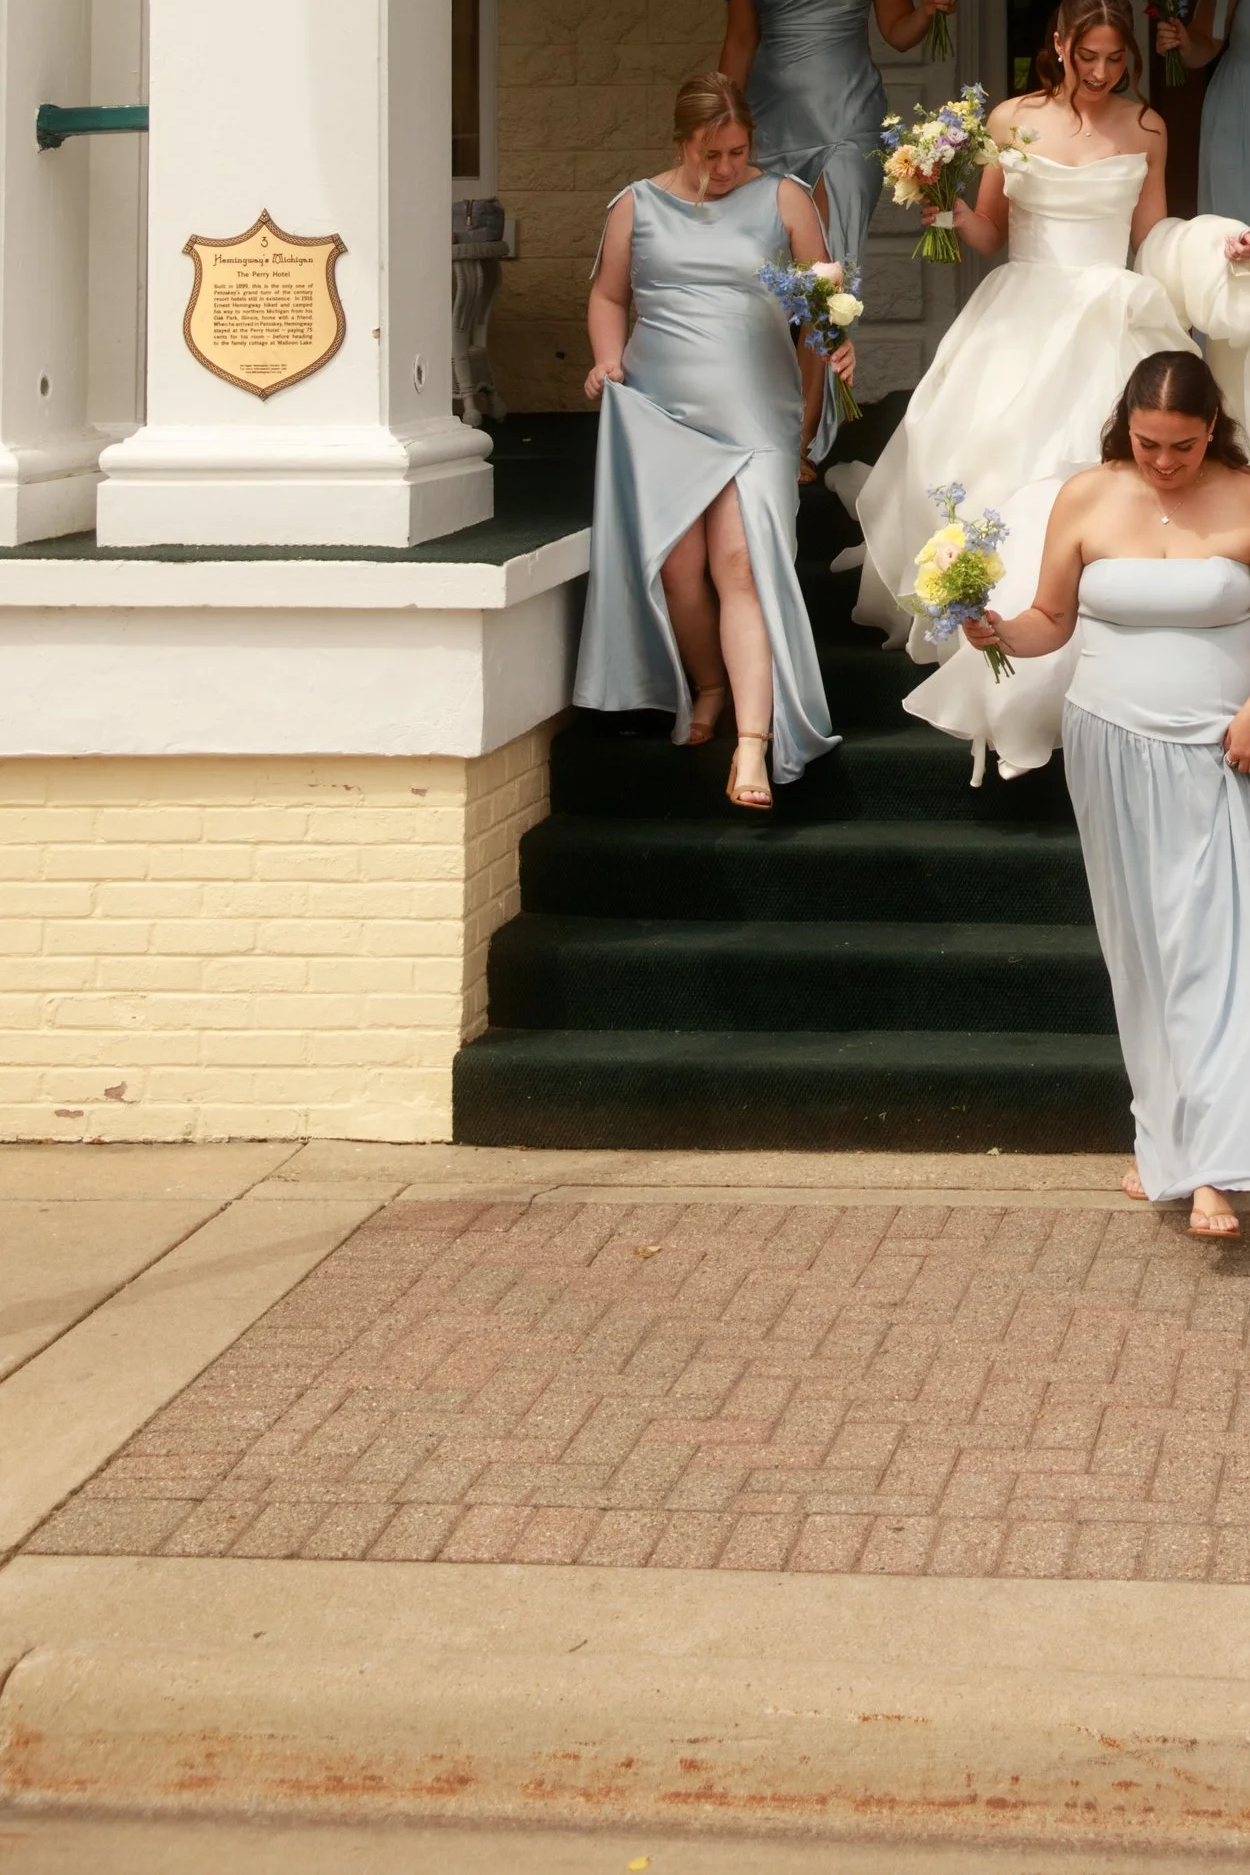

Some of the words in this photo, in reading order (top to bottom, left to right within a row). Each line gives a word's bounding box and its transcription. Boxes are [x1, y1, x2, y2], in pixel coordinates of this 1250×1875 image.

[260, 236, 269, 248] 3
[213, 253, 269, 267] Hemingway's
[272, 253, 313, 267] Michigan
[252, 271, 269, 279] Perry
